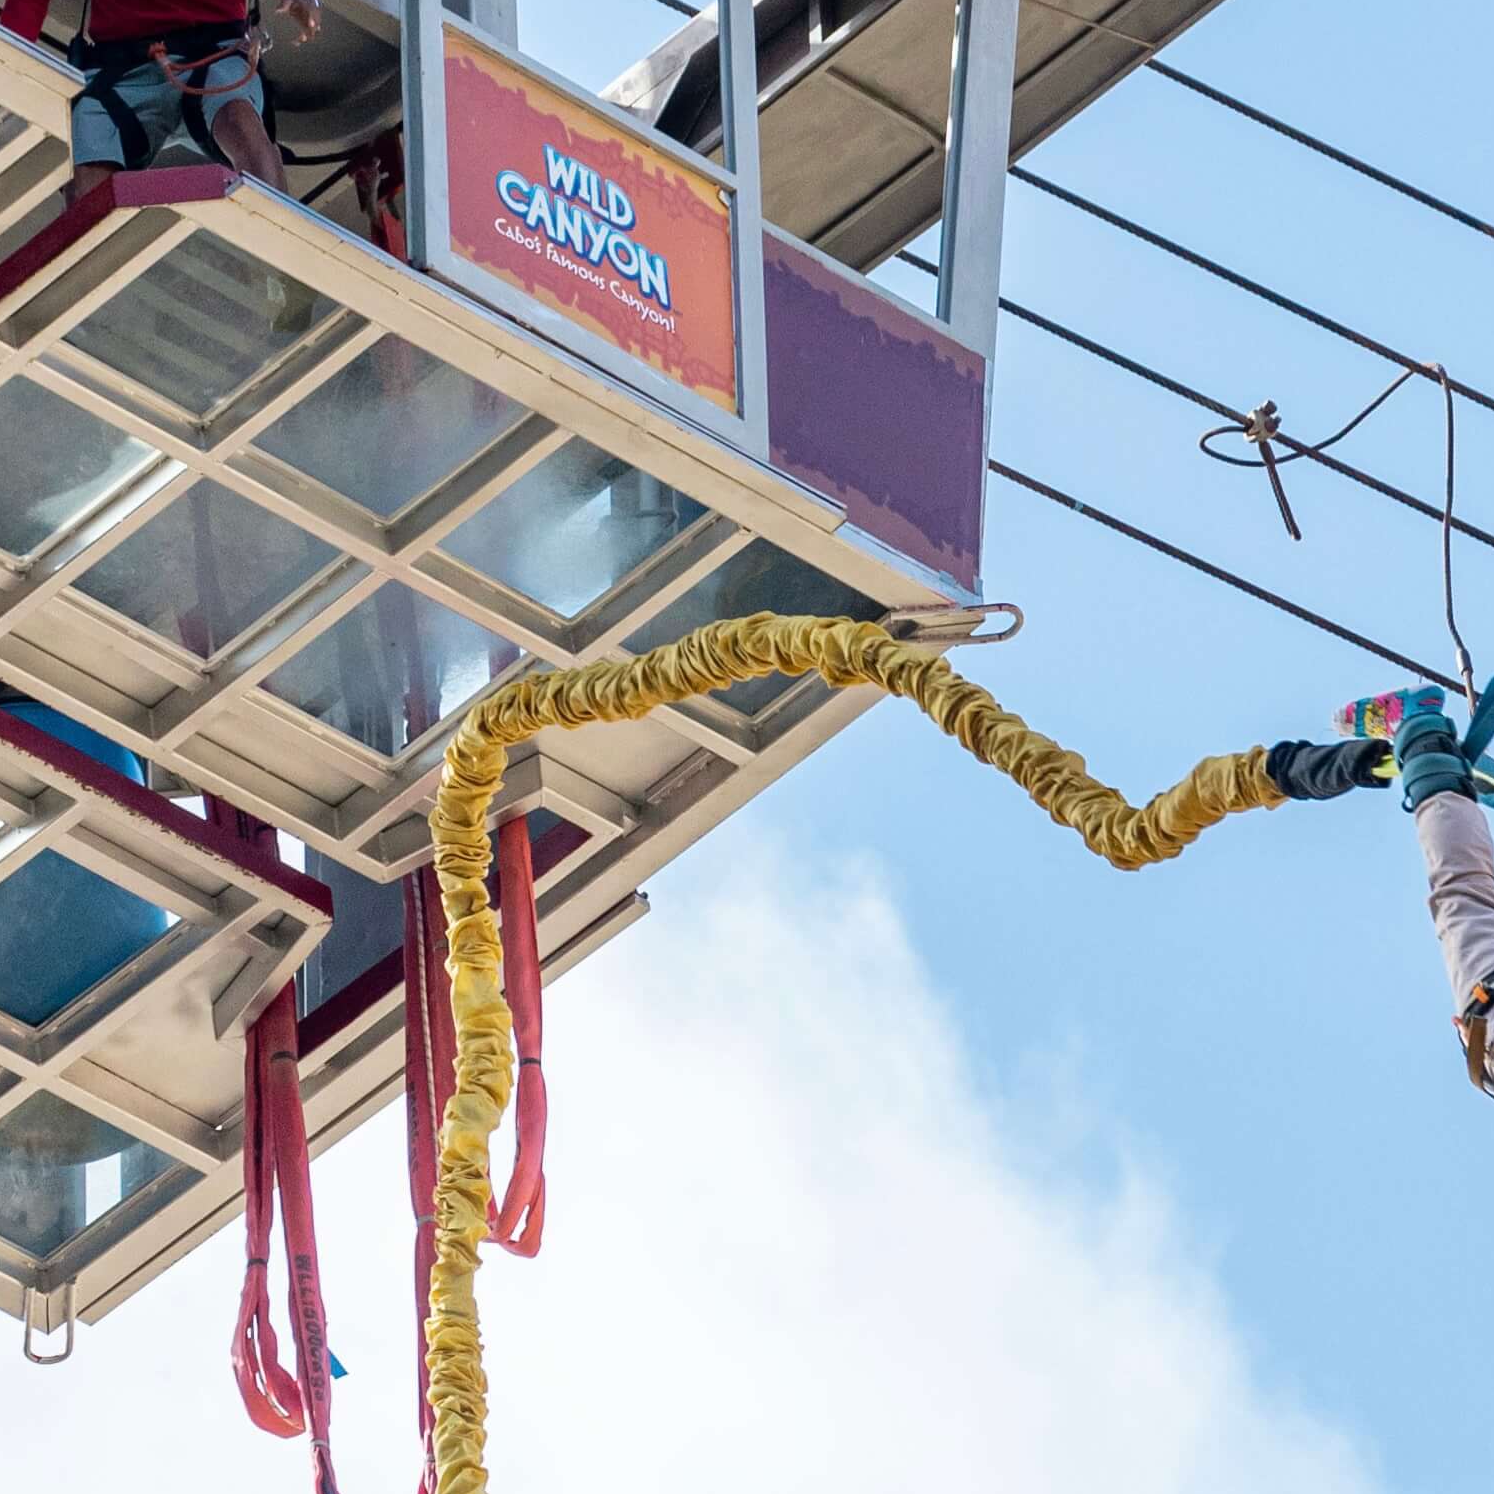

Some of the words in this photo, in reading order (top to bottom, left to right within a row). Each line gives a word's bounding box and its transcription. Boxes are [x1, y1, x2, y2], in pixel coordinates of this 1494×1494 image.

[494, 169, 672, 312] CANYON
[541, 142, 636, 232] WILD
[493, 217, 542, 255] Cabo's
[609, 279, 677, 335] Canyon!
